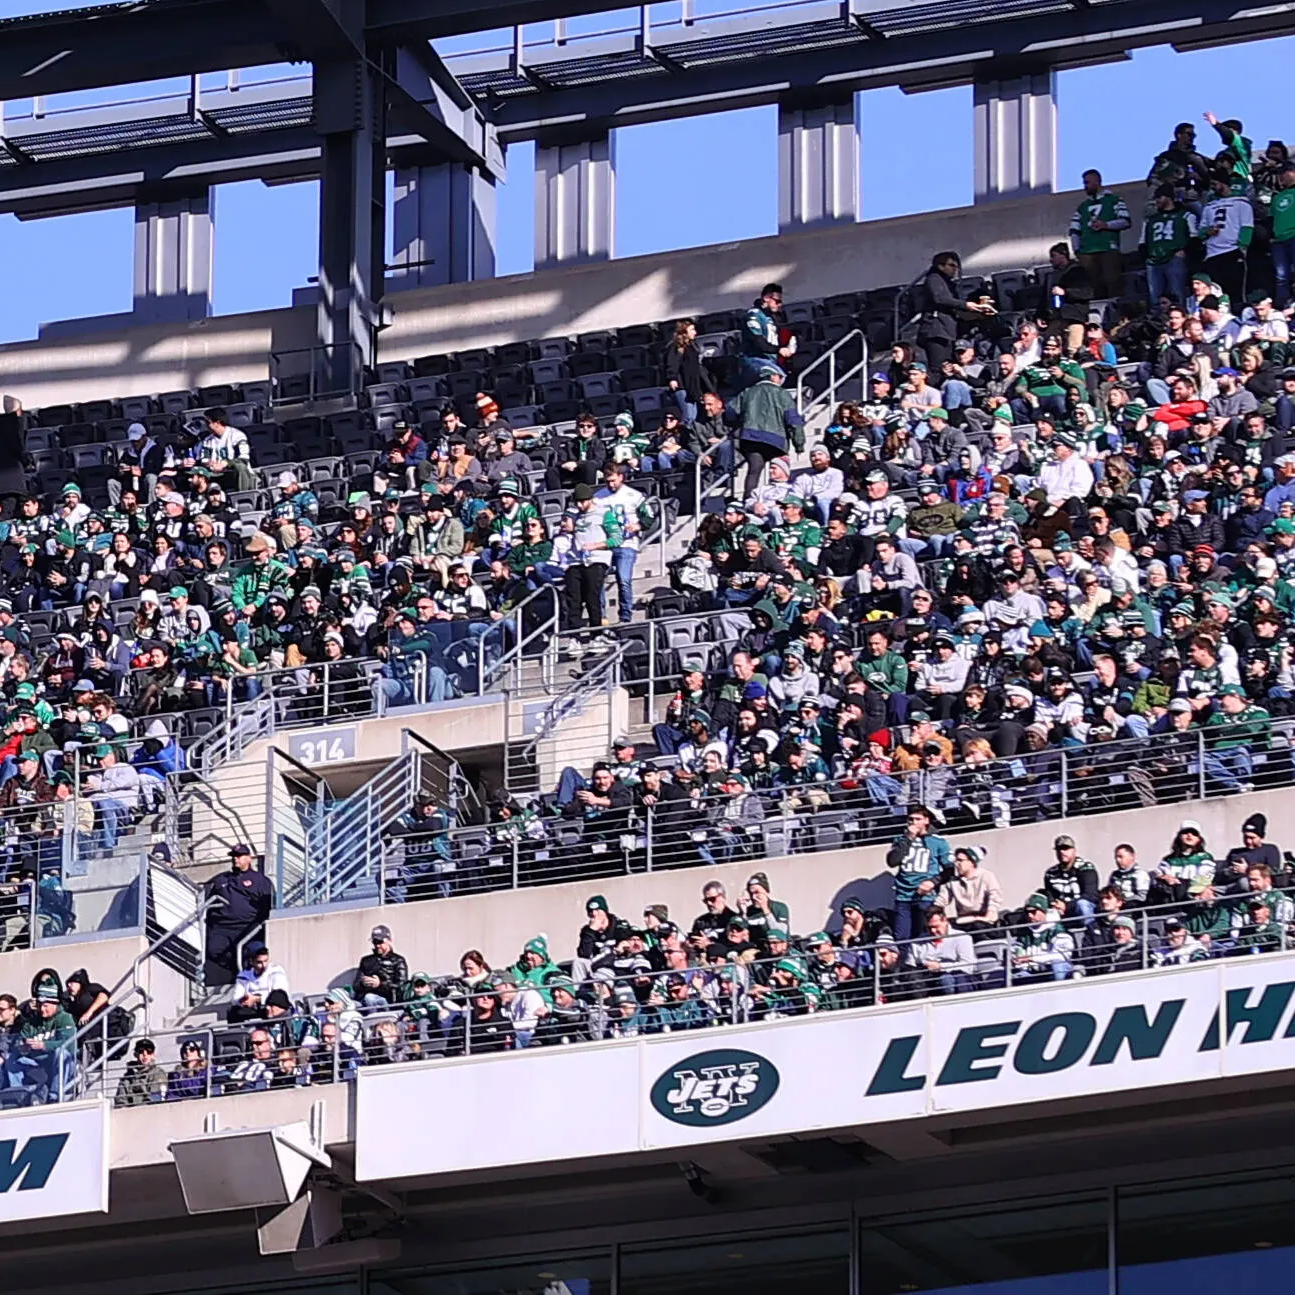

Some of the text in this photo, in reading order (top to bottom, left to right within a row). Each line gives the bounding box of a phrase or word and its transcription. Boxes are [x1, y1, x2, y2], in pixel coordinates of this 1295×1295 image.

[1152, 220, 1173, 242] 24
[299, 737, 345, 764] 314
[865, 981, 1295, 1096] LEON H
[667, 1073, 759, 1104] JETS
